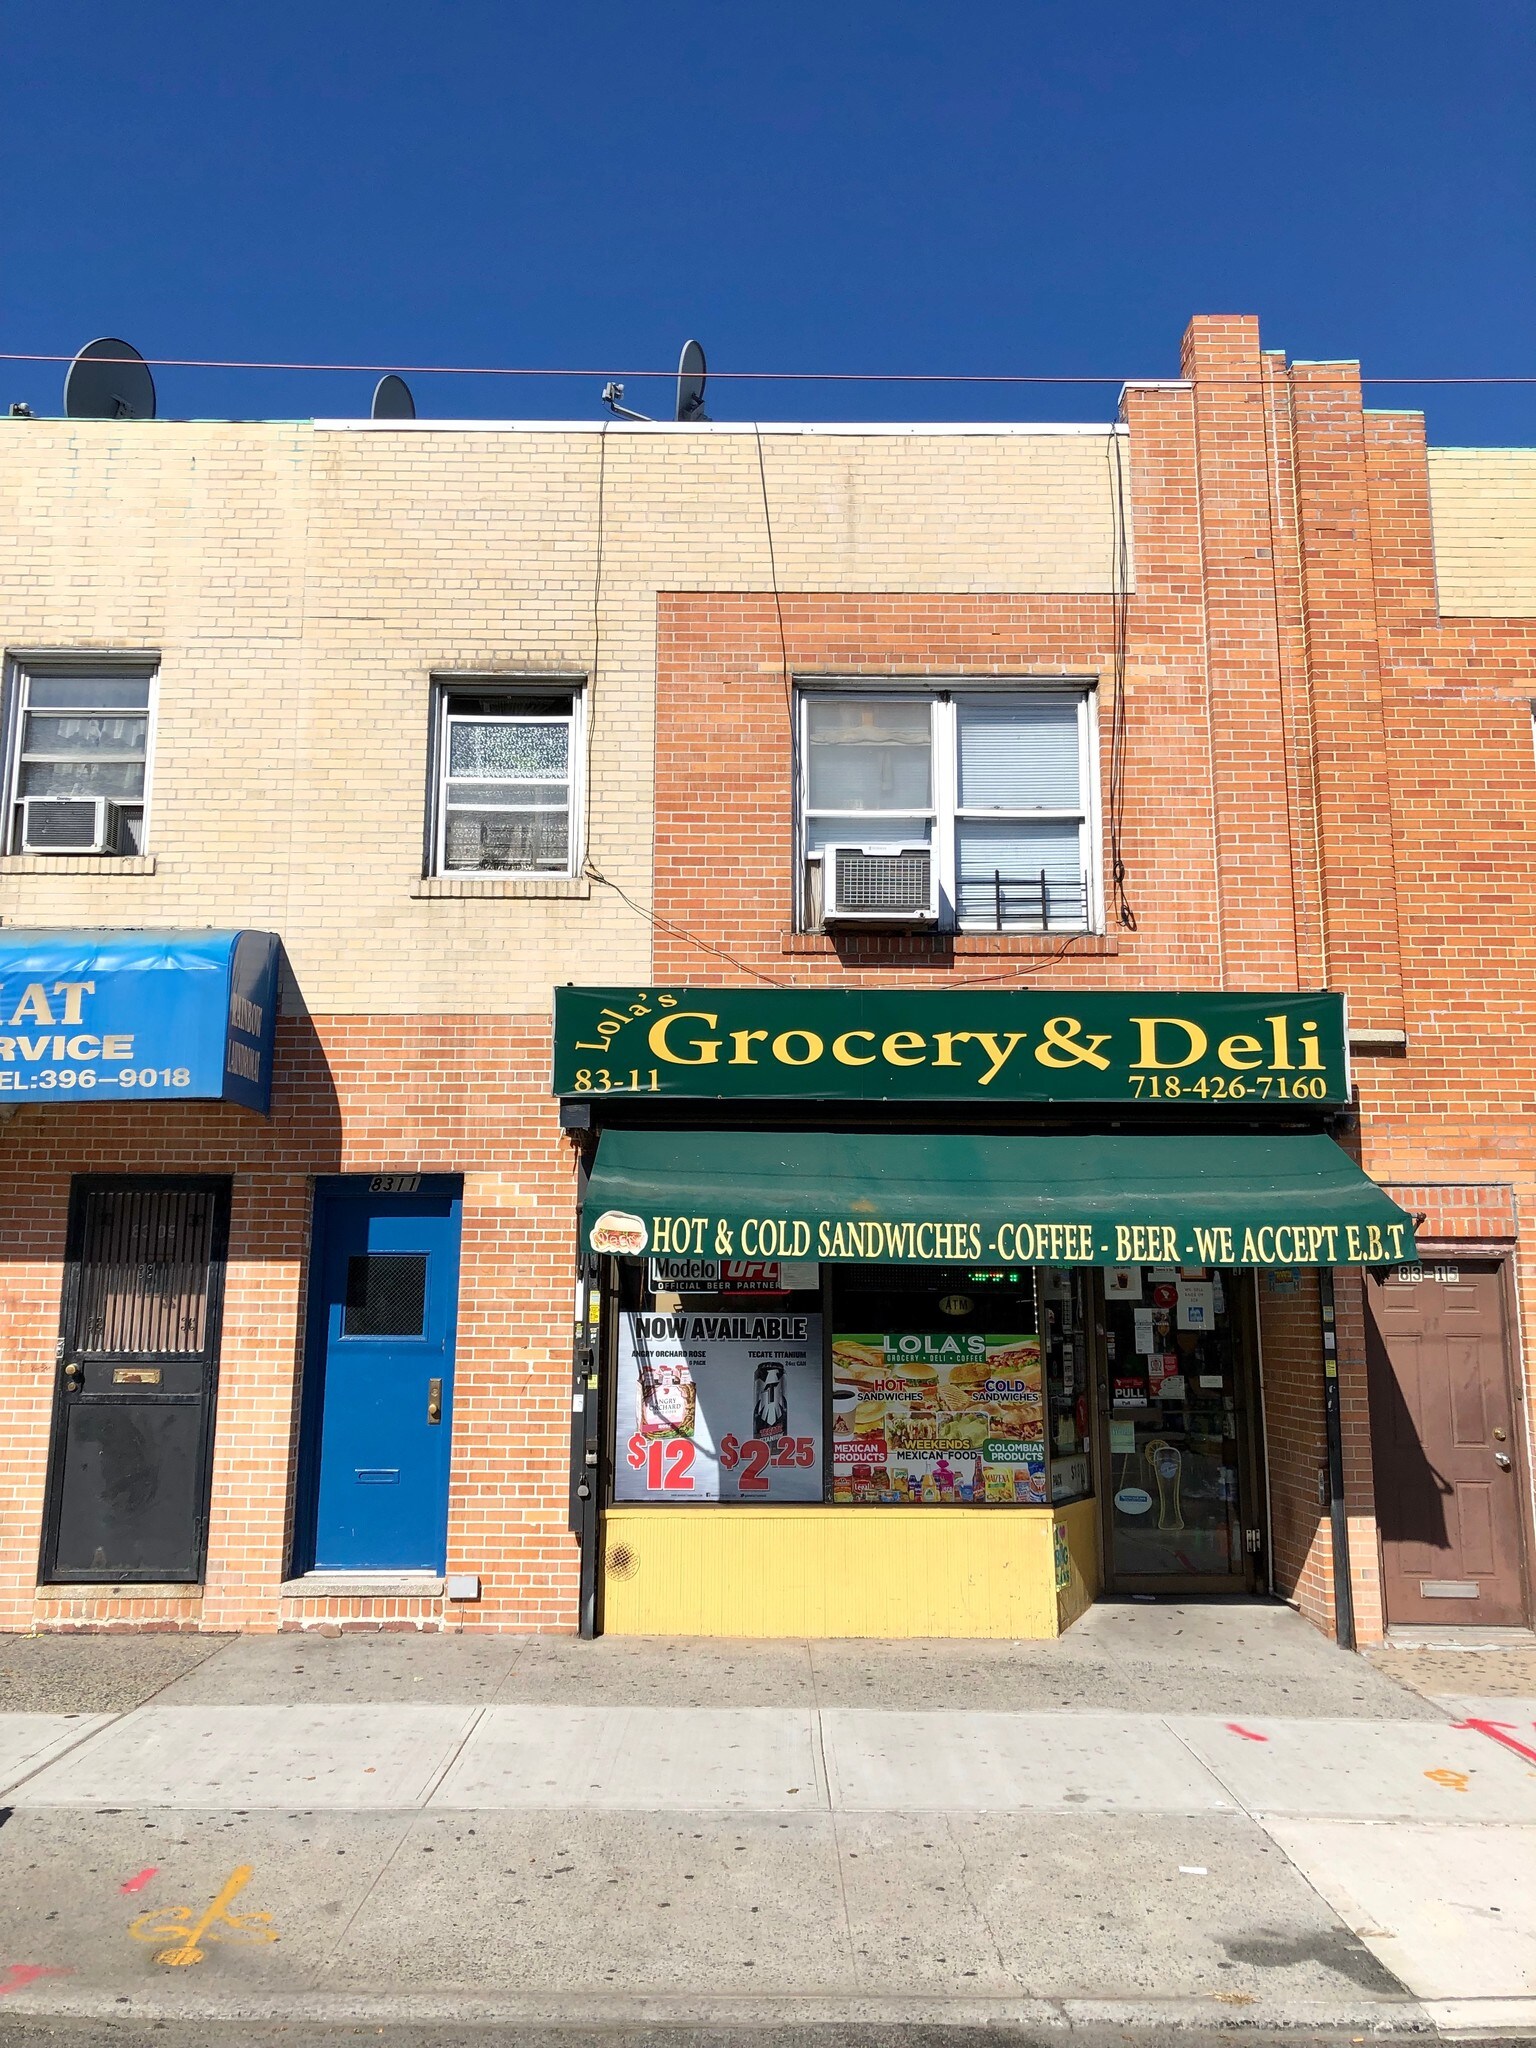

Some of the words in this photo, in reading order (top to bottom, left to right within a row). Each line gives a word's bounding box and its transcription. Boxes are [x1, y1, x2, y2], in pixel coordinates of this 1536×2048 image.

[0, 980, 95, 1026] AT
[575, 992, 678, 1053] Lola's
[648, 1012, 1027, 1086] Grocery
[1034, 1016, 1112, 1072] &
[1129, 1014, 1327, 1070] Deli
[574, 1068, 662, 1093] 83-11
[1128, 1075, 1327, 1100] 718-426-7160
[371, 1177, 417, 1192] 8311
[652, 1216, 709, 1255] HOT
[714, 1219, 734, 1256] &
[740, 1219, 811, 1257] COLD
[817, 1221, 982, 1260] SANDWICHES
[1115, 1225, 1181, 1262] BEER
[1241, 1225, 1339, 1263] ACCEPT
[1345, 1224, 1406, 1262] E.B.T
[654, 1260, 715, 1279] Modelo
[1399, 1266, 1459, 1282] 83-15
[657, 1281, 701, 1290] OFFICIAL
[706, 1281, 731, 1290] BEER
[737, 1281, 781, 1290] PARTNER
[945, 1299, 968, 1310] ATM
[635, 1317, 688, 1341] NOW
[691, 1317, 808, 1341] AVAILABLE
[883, 1335, 986, 1354] LOLA'S
[873, 1379, 906, 1392] HOT
[985, 1380, 1026, 1392] COLD
[857, 1392, 924, 1401] SANDWICHES
[971, 1393, 1039, 1401] SANDWICHES
[1115, 1388, 1144, 1398] PULL
[834, 1444, 878, 1453] MEXICAN
[904, 1439, 971, 1450] WEEKENDS
[988, 1443, 1045, 1452] COLOMBIAN
[627, 1432, 695, 1491] $12
[719, 1432, 815, 1491] $2.25
[833, 1453, 885, 1462] PRODUCTS
[897, 1451, 943, 1461] MEXICAN
[948, 1451, 978, 1460] FOOD
[991, 1452, 1044, 1461] PRODUCTS
